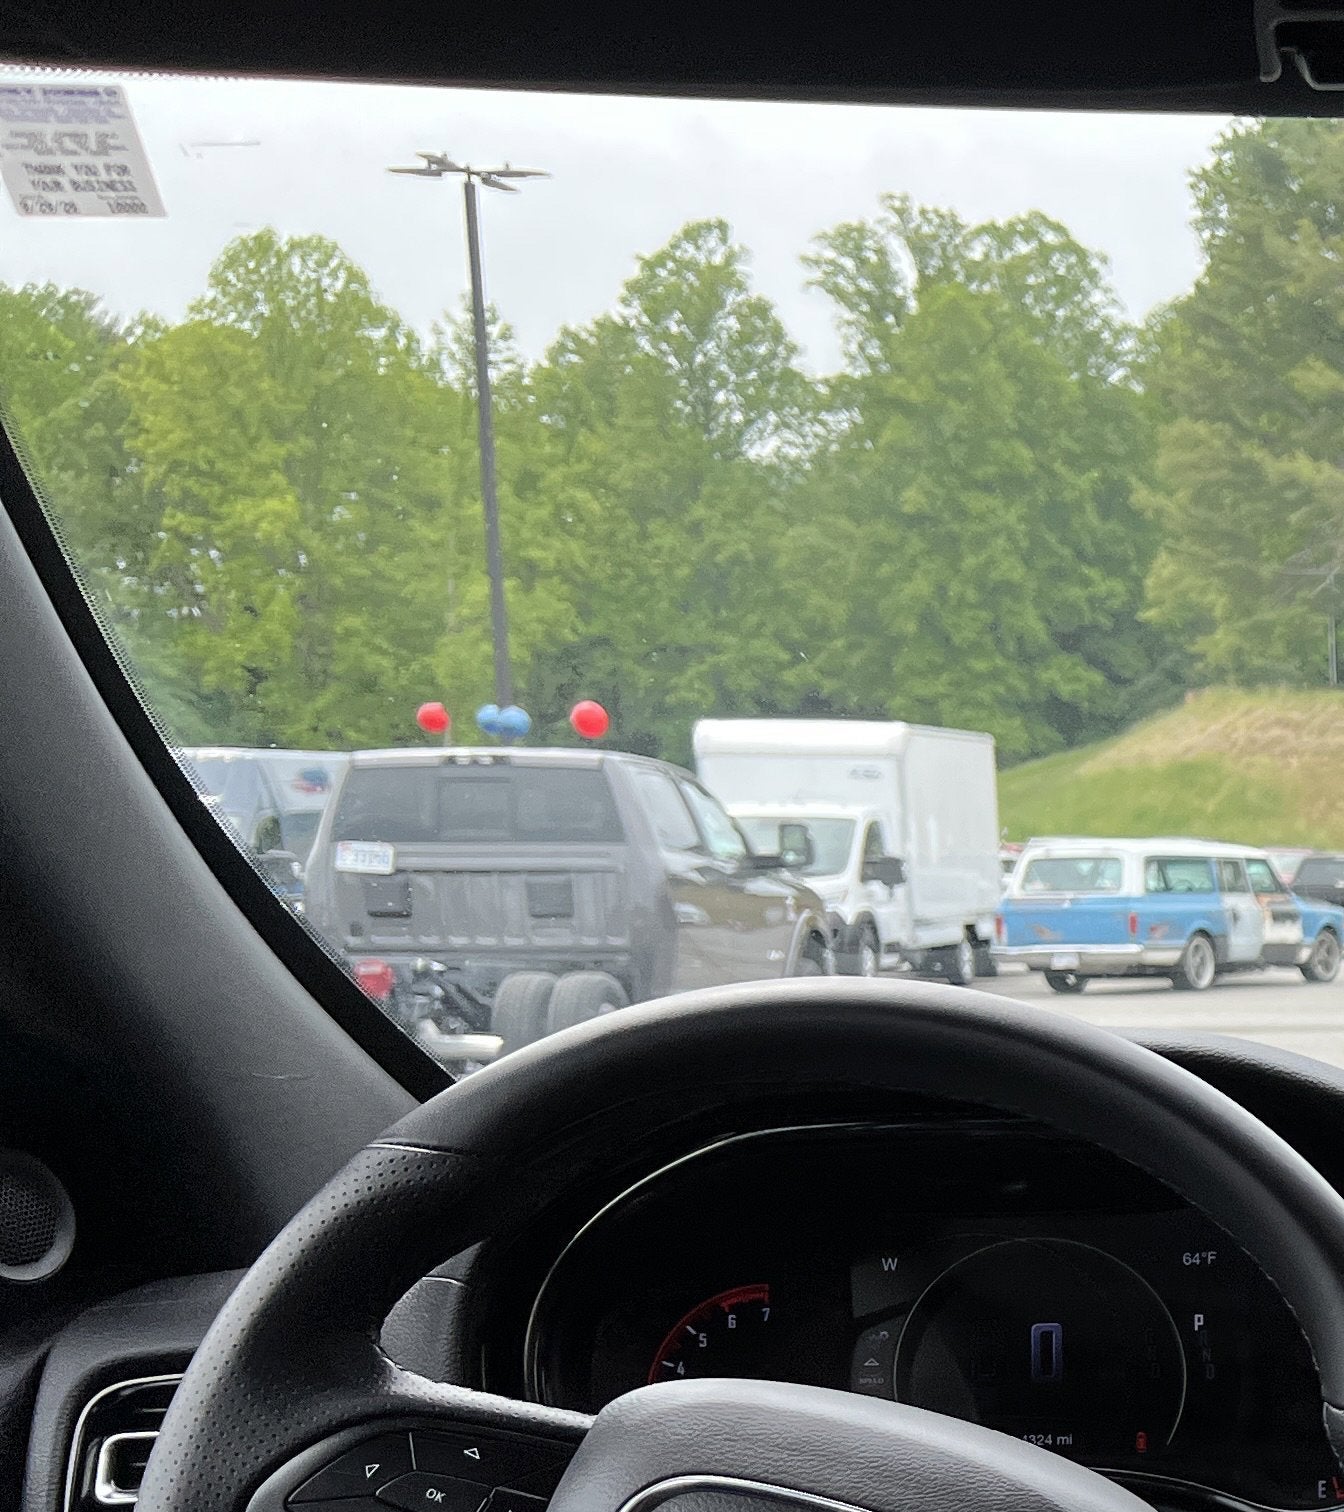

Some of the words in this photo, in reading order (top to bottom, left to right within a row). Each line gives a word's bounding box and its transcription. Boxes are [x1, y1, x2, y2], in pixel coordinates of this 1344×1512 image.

[881, 1257, 898, 1271] W
[727, 1314, 737, 1329] 6
[761, 1307, 771, 1323] 7
[1194, 1313, 1205, 1332] P
[698, 1333, 708, 1348] 5
[676, 1361, 686, 1376] 4
[1056, 1433, 1073, 1446] mi
[424, 1487, 447, 1504] OK
[1317, 1482, 1327, 1499] E
